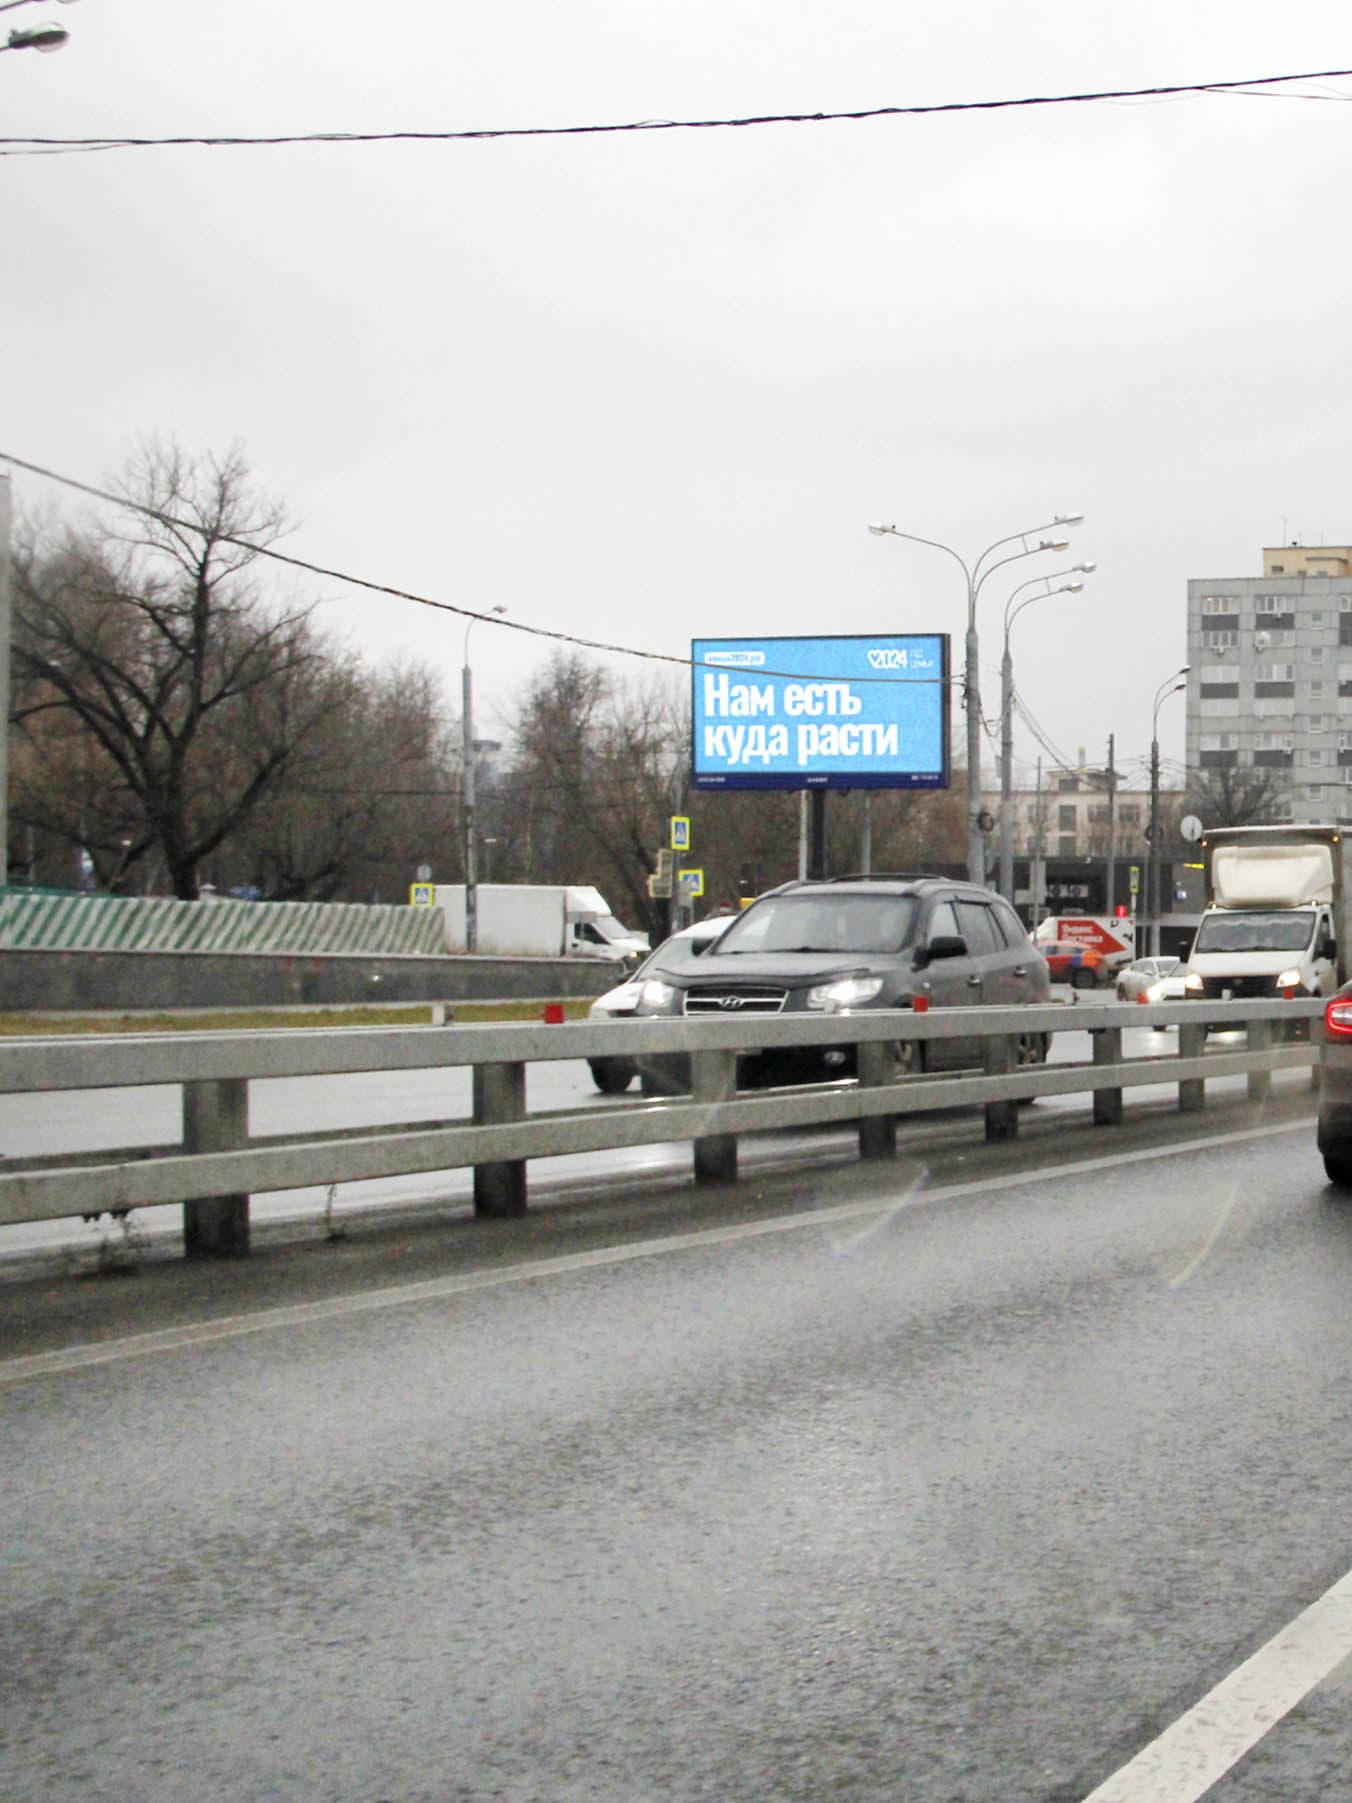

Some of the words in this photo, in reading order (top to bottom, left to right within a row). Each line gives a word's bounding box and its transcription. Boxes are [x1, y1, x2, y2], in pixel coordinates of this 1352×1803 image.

[704, 672, 775, 717] Нам
[783, 683, 863, 717] есть
[704, 723, 789, 765] куда
[797, 722, 899, 766] расти
